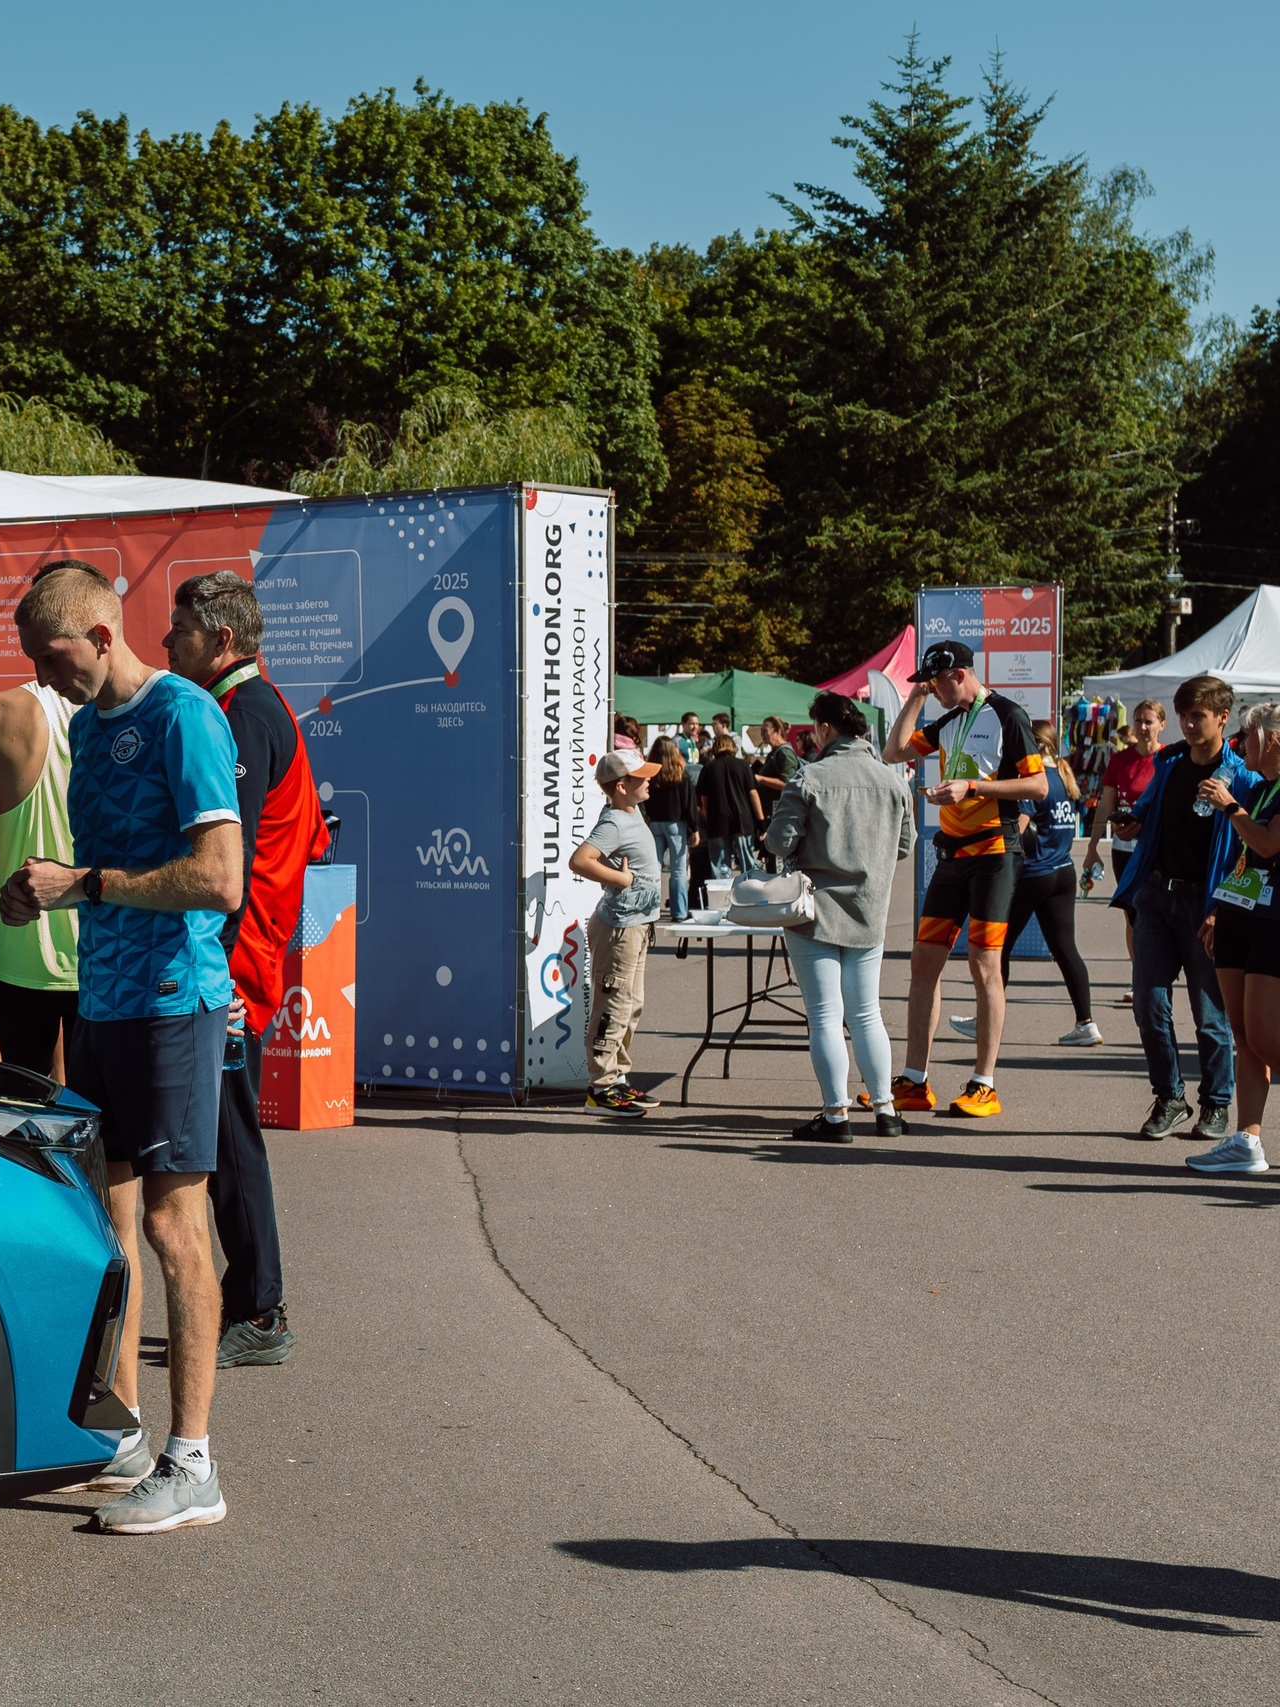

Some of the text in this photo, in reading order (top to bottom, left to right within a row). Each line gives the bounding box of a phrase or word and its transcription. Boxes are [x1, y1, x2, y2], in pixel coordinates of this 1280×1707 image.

[276, 578, 298, 588] ТУЛА
[433, 573, 469, 591] 2025
[296, 600, 330, 610] забегов
[290, 614, 338, 624] количество
[958, 618, 1006, 626] КАЛЕНДАРЬ
[262, 629, 300, 639] вигаемся
[310, 626, 342, 638] лучшим
[958, 626, 1006, 637] СОБЫТИЙ
[1010, 617, 1051, 636] 2025
[278, 642, 308, 652] забега.
[310, 640, 353, 652] Встречаем
[272, 656, 312, 667] регионов
[314, 655, 344, 664] России.
[415, 702, 486, 714] ВЫ НАХОДИТЕСЬ
[542, 524, 562, 886] TULAMARATHON.ORG
[309, 720, 342, 736] 2024
[437, 717, 464, 728] ЗДЕСЬ
[570, 608, 586, 883] #ЛЬСКИЙМАРАФОН
[416, 880, 490, 890] ТУЛЬСКИЙ МАРАФОН
[262, 1046, 332, 1058] ЛЬСКИЙ МАРАФОН
